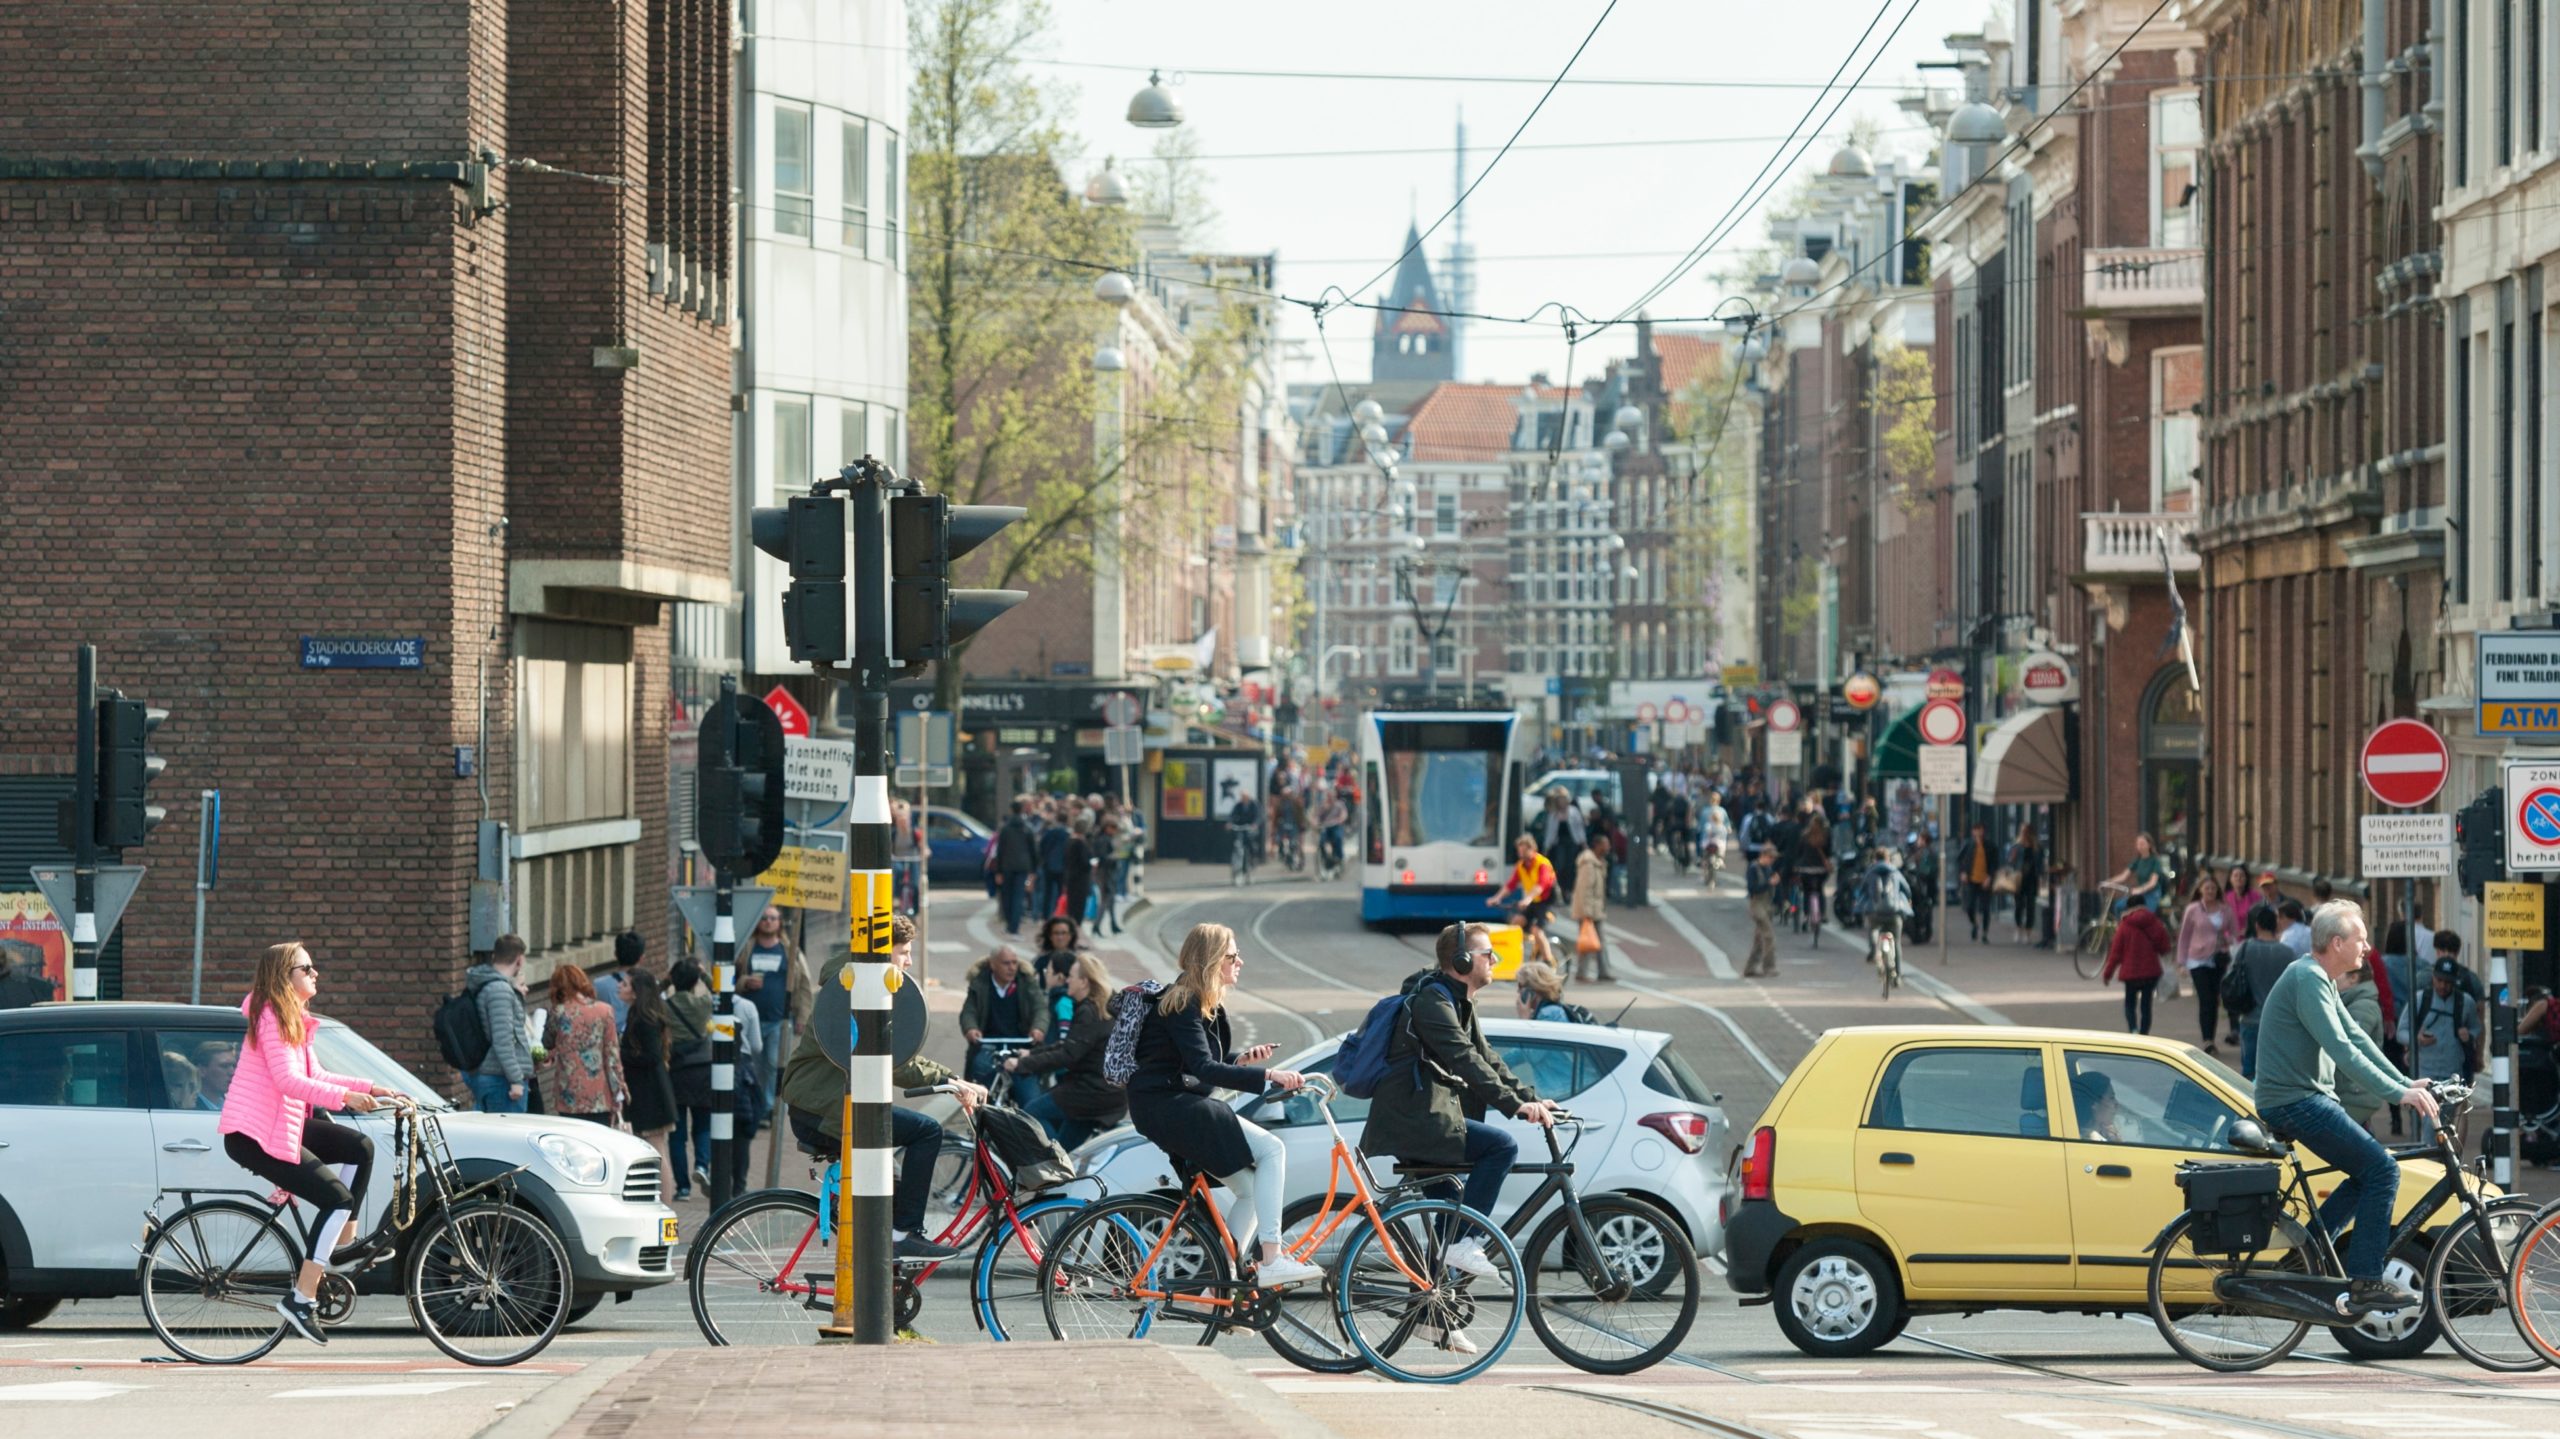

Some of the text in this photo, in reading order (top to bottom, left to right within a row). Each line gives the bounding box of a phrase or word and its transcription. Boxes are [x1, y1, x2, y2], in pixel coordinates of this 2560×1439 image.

[308, 640, 416, 655] STADHOUDERSKADE
[400, 656, 419, 666] ZUID
[2485, 653, 2548, 666] FERDINAND
[2496, 670, 2519, 683] FINE
[2500, 707, 2559, 728] ATM
[797, 746, 853, 767] ontheffing
[787, 761, 832, 779] niet van
[2368, 818, 2444, 830] Uitgezonderd
[2368, 831, 2444, 844] (snor)fietsers
[2375, 849, 2440, 861] Taxiontheffing
[2364, 862, 2451, 873] niet van toepassing
[2490, 889, 2505, 902] Geen
[2489, 911, 2497, 920] en
[2488, 926, 2541, 941] handel toegestaan
